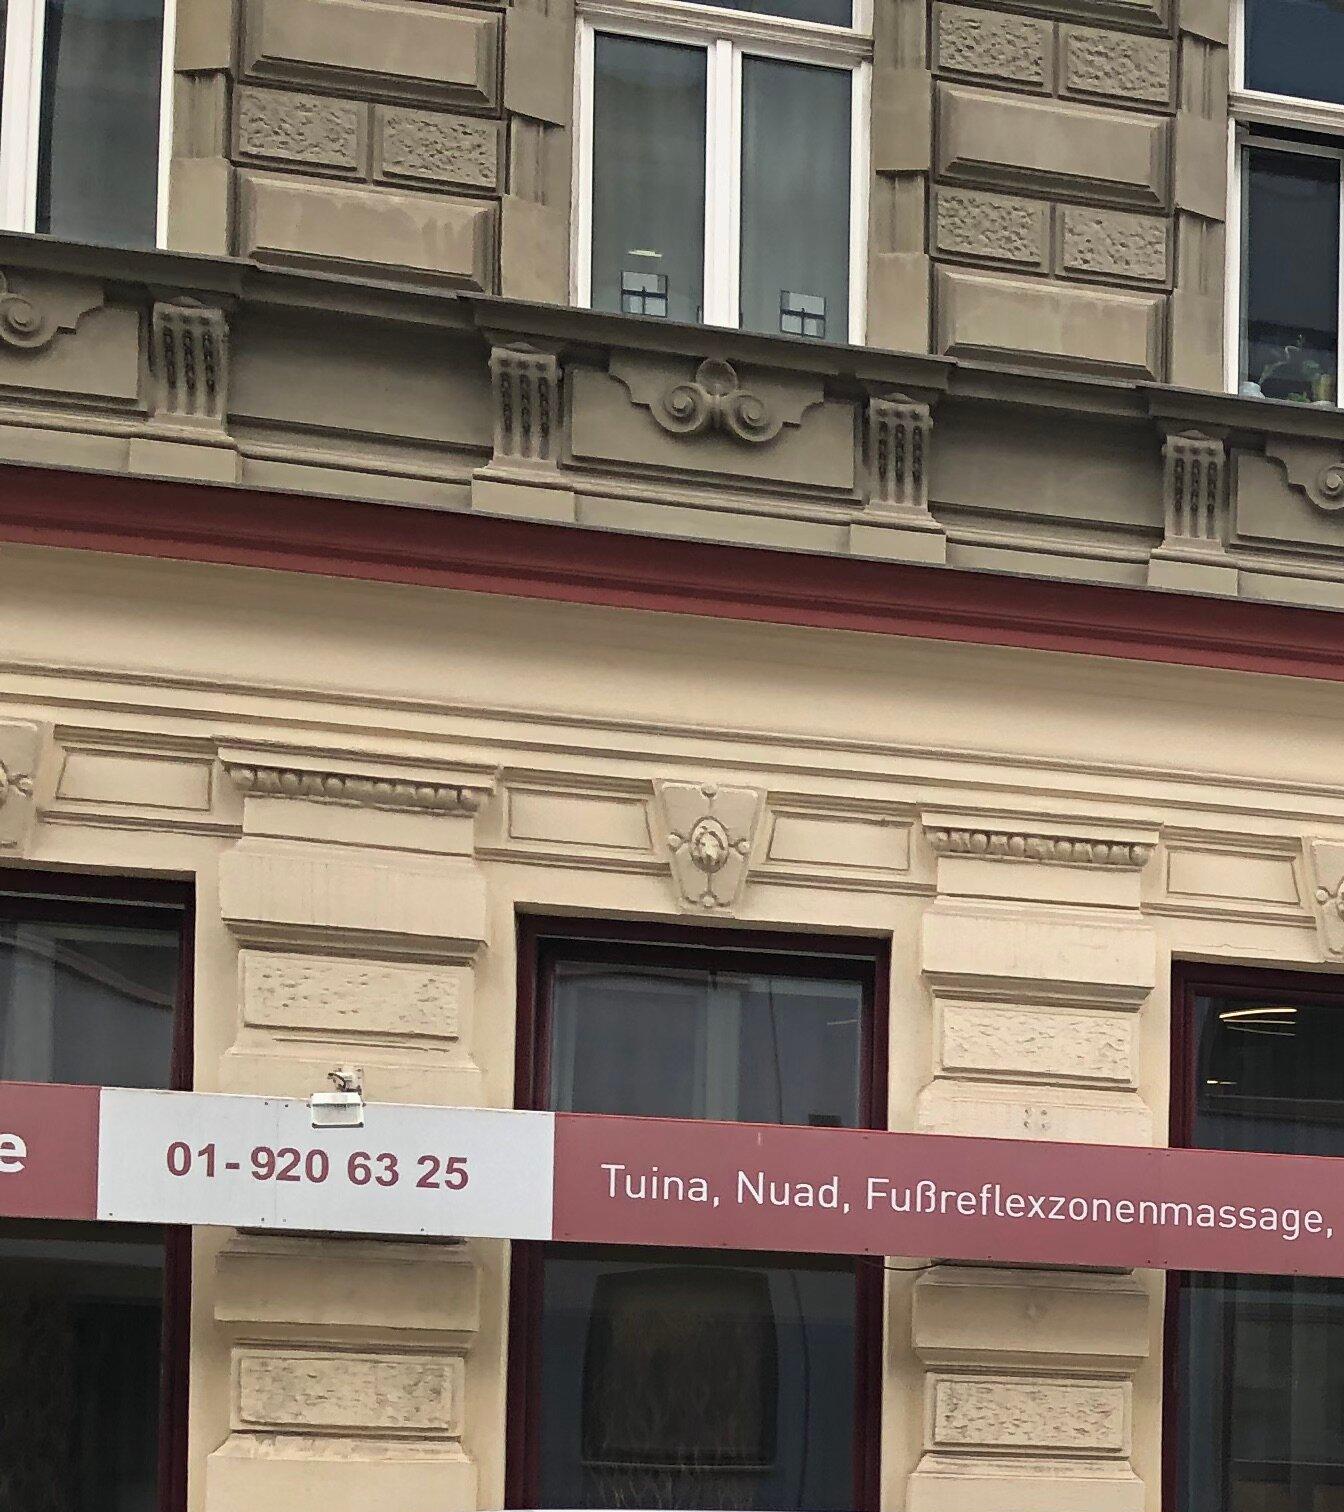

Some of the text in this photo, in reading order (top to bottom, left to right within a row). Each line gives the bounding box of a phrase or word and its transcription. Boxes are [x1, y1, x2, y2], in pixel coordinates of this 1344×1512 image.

[347, 1151, 400, 1187] 63
[415, 1154, 469, 1191] 25
[600, 1163, 720, 1208] Tuina,
[737, 1170, 850, 1214] Nuad,
[866, 1177, 1333, 1241] Fußreflexzonenmassage,
